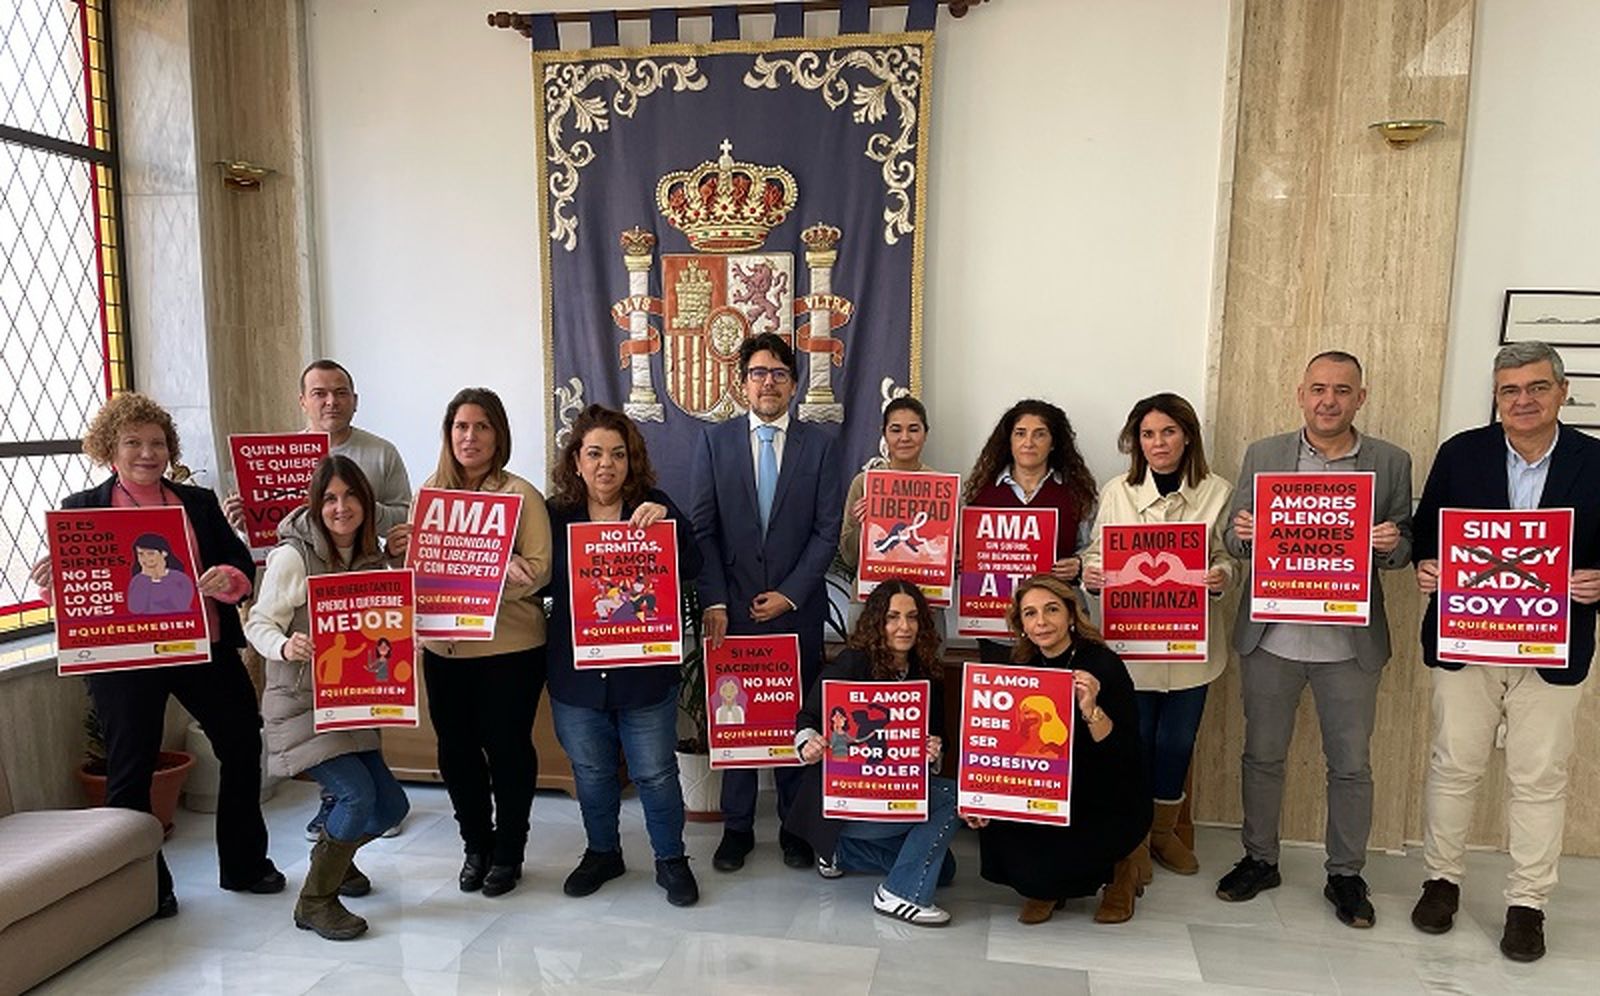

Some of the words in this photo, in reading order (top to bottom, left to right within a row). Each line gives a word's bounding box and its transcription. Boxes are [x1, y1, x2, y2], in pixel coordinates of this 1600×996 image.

[240, 444, 285, 458] QUIEN
[289, 443, 321, 454] BIEN
[247, 460, 265, 470] TE
[268, 458, 318, 471] QUIERE
[256, 475, 274, 485] TE
[872, 478, 888, 495] EL
[892, 480, 931, 498] AMOR
[936, 482, 952, 499] ES
[1272, 484, 1357, 495] QUEREMOS
[1270, 496, 1356, 509] AMORES
[871, 498, 950, 521] LIBERTAD
[421, 498, 506, 536] AMA
[1271, 512, 1354, 527] PLENOS,
[56, 521, 71, 530] SI
[76, 520, 94, 529] ES
[976, 514, 1040, 540] AMA
[1464, 521, 1511, 539] SIN
[1520, 521, 1546, 539] TI
[58, 533, 114, 543] DOLOR
[419, 533, 441, 545] CON
[601, 530, 622, 541] NO
[627, 530, 645, 540] LO
[1270, 528, 1354, 540] AMORES
[1110, 533, 1126, 550] EL
[1132, 532, 1176, 550] AMOR
[1181, 532, 1199, 549] ES
[60, 546, 81, 556] LO
[85, 544, 118, 556] QUE
[418, 547, 440, 559] CON
[443, 550, 498, 563] LIBERTAD
[1277, 543, 1345, 555] SANOS
[592, 555, 609, 566] EL
[613, 554, 656, 565] AMOR
[1268, 558, 1280, 570] Y
[1286, 558, 1354, 572] LIBRES
[414, 560, 422, 571] Y
[424, 562, 444, 573] CON
[448, 565, 499, 577] RESPETO
[580, 568, 603, 578] NO
[607, 566, 669, 576] LASTIMA
[62, 571, 87, 581] NO
[91, 569, 110, 578] ES
[64, 582, 113, 593] AMOR
[980, 572, 998, 597] A
[1261, 580, 1360, 591] #QUIÉREMEBIEN
[65, 594, 86, 604] LO
[90, 592, 124, 604] QUE
[417, 595, 490, 605] QUIÉREMEBIEN
[1110, 590, 1198, 609] CONFIANZA
[65, 606, 114, 617] VIVES
[1448, 596, 1509, 615] SOY
[1516, 597, 1559, 617] YO
[68, 620, 195, 637] #QUIÉREMEBIEN
[318, 611, 403, 634] MEJOR
[1448, 620, 1558, 632] #QUIÉREMEBIEN
[732, 648, 742, 658] SI
[747, 648, 772, 656] HAY
[744, 678, 762, 688] NO
[767, 678, 793, 687] HAY
[973, 674, 990, 685] EL
[994, 675, 1039, 688] AMOR
[754, 692, 794, 702] AMOR
[850, 692, 868, 703] EL
[872, 692, 921, 703] AMOR
[972, 689, 1014, 711] NO
[890, 707, 921, 721] NO
[971, 717, 1010, 730] DEBE
[875, 729, 920, 740] TIENE
[970, 736, 998, 748] SER
[850, 746, 883, 758] POR
[887, 746, 920, 760] QUE
[969, 754, 1050, 771] POSESIVO
[862, 766, 920, 776] DOLER
